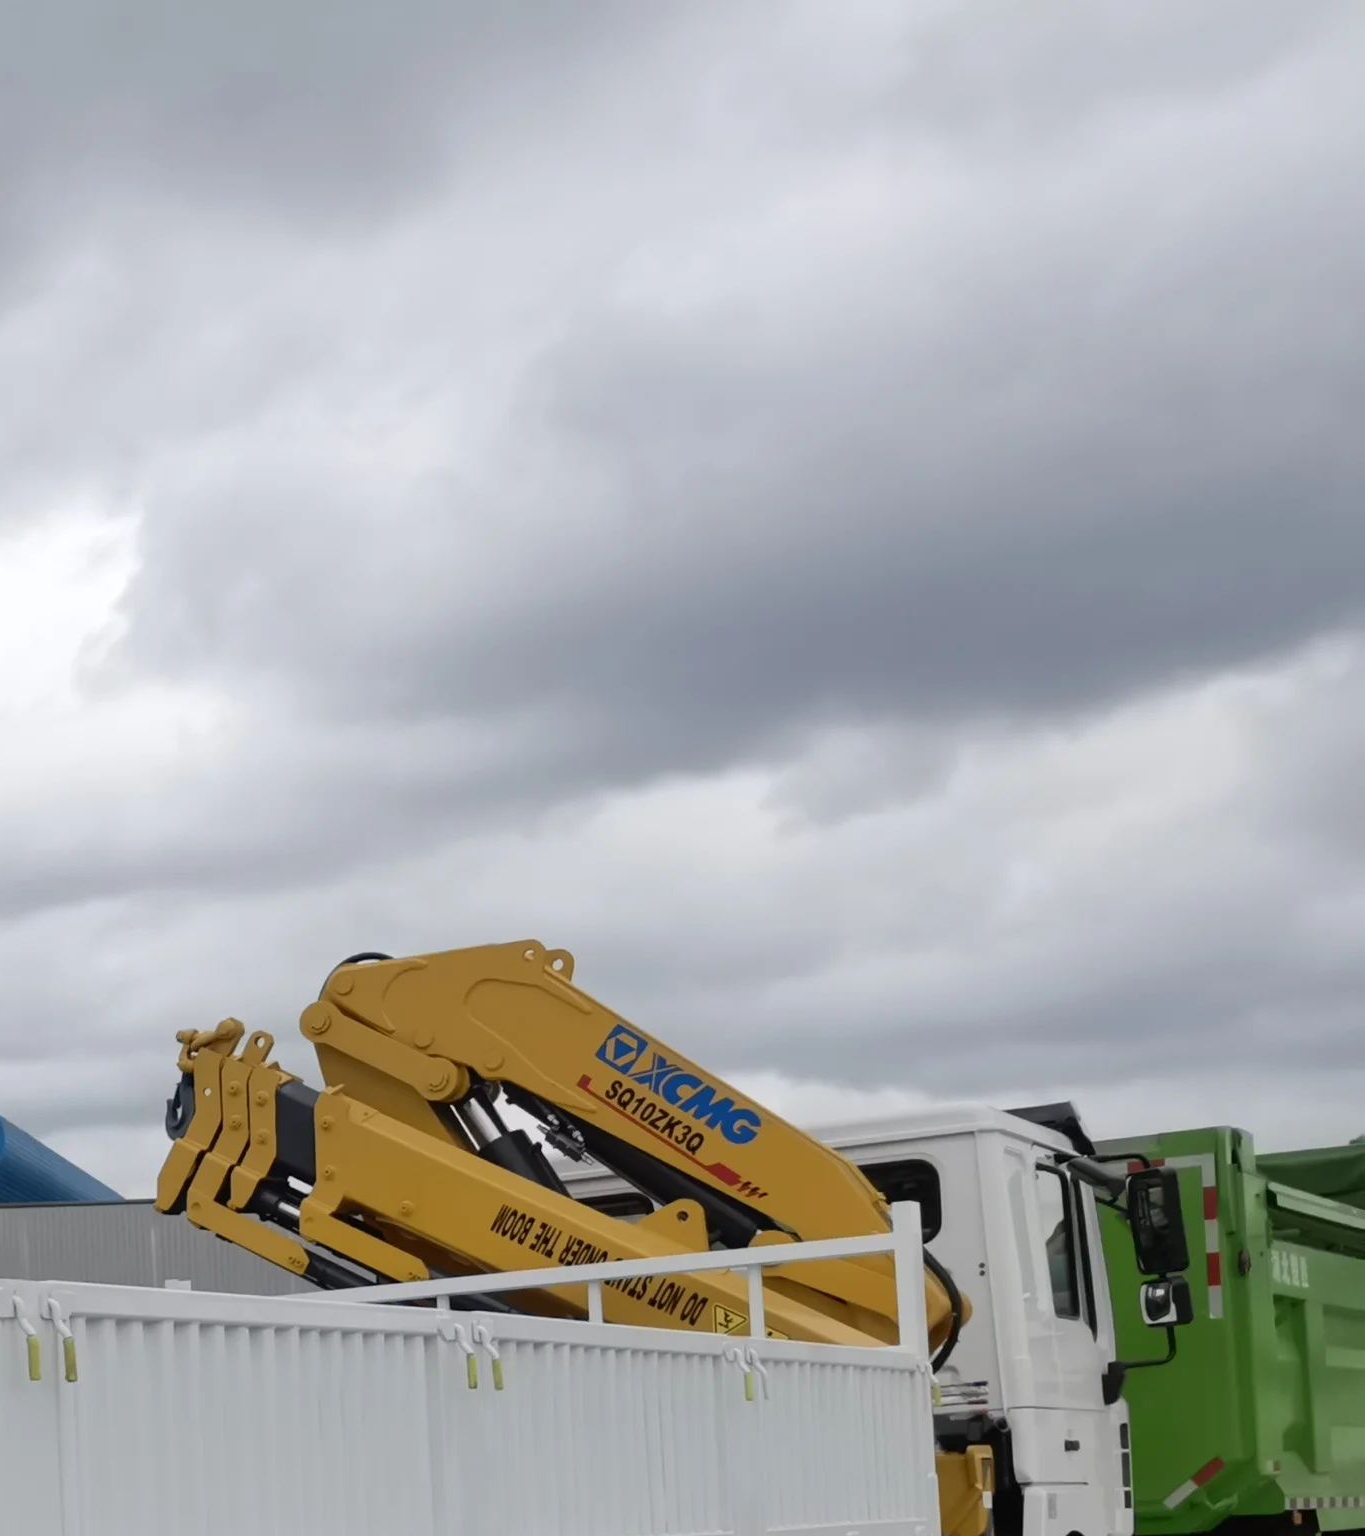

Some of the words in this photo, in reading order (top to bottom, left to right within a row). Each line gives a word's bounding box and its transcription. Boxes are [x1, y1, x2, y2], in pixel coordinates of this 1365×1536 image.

[605, 1080, 705, 1155] SQ10ZK3Q
[627, 1052, 762, 1144] XCMG
[490, 1204, 536, 1245] BOOM
[529, 1222, 562, 1258] THE
[648, 1278, 685, 1316] NOT
[680, 1292, 709, 1327] DO
